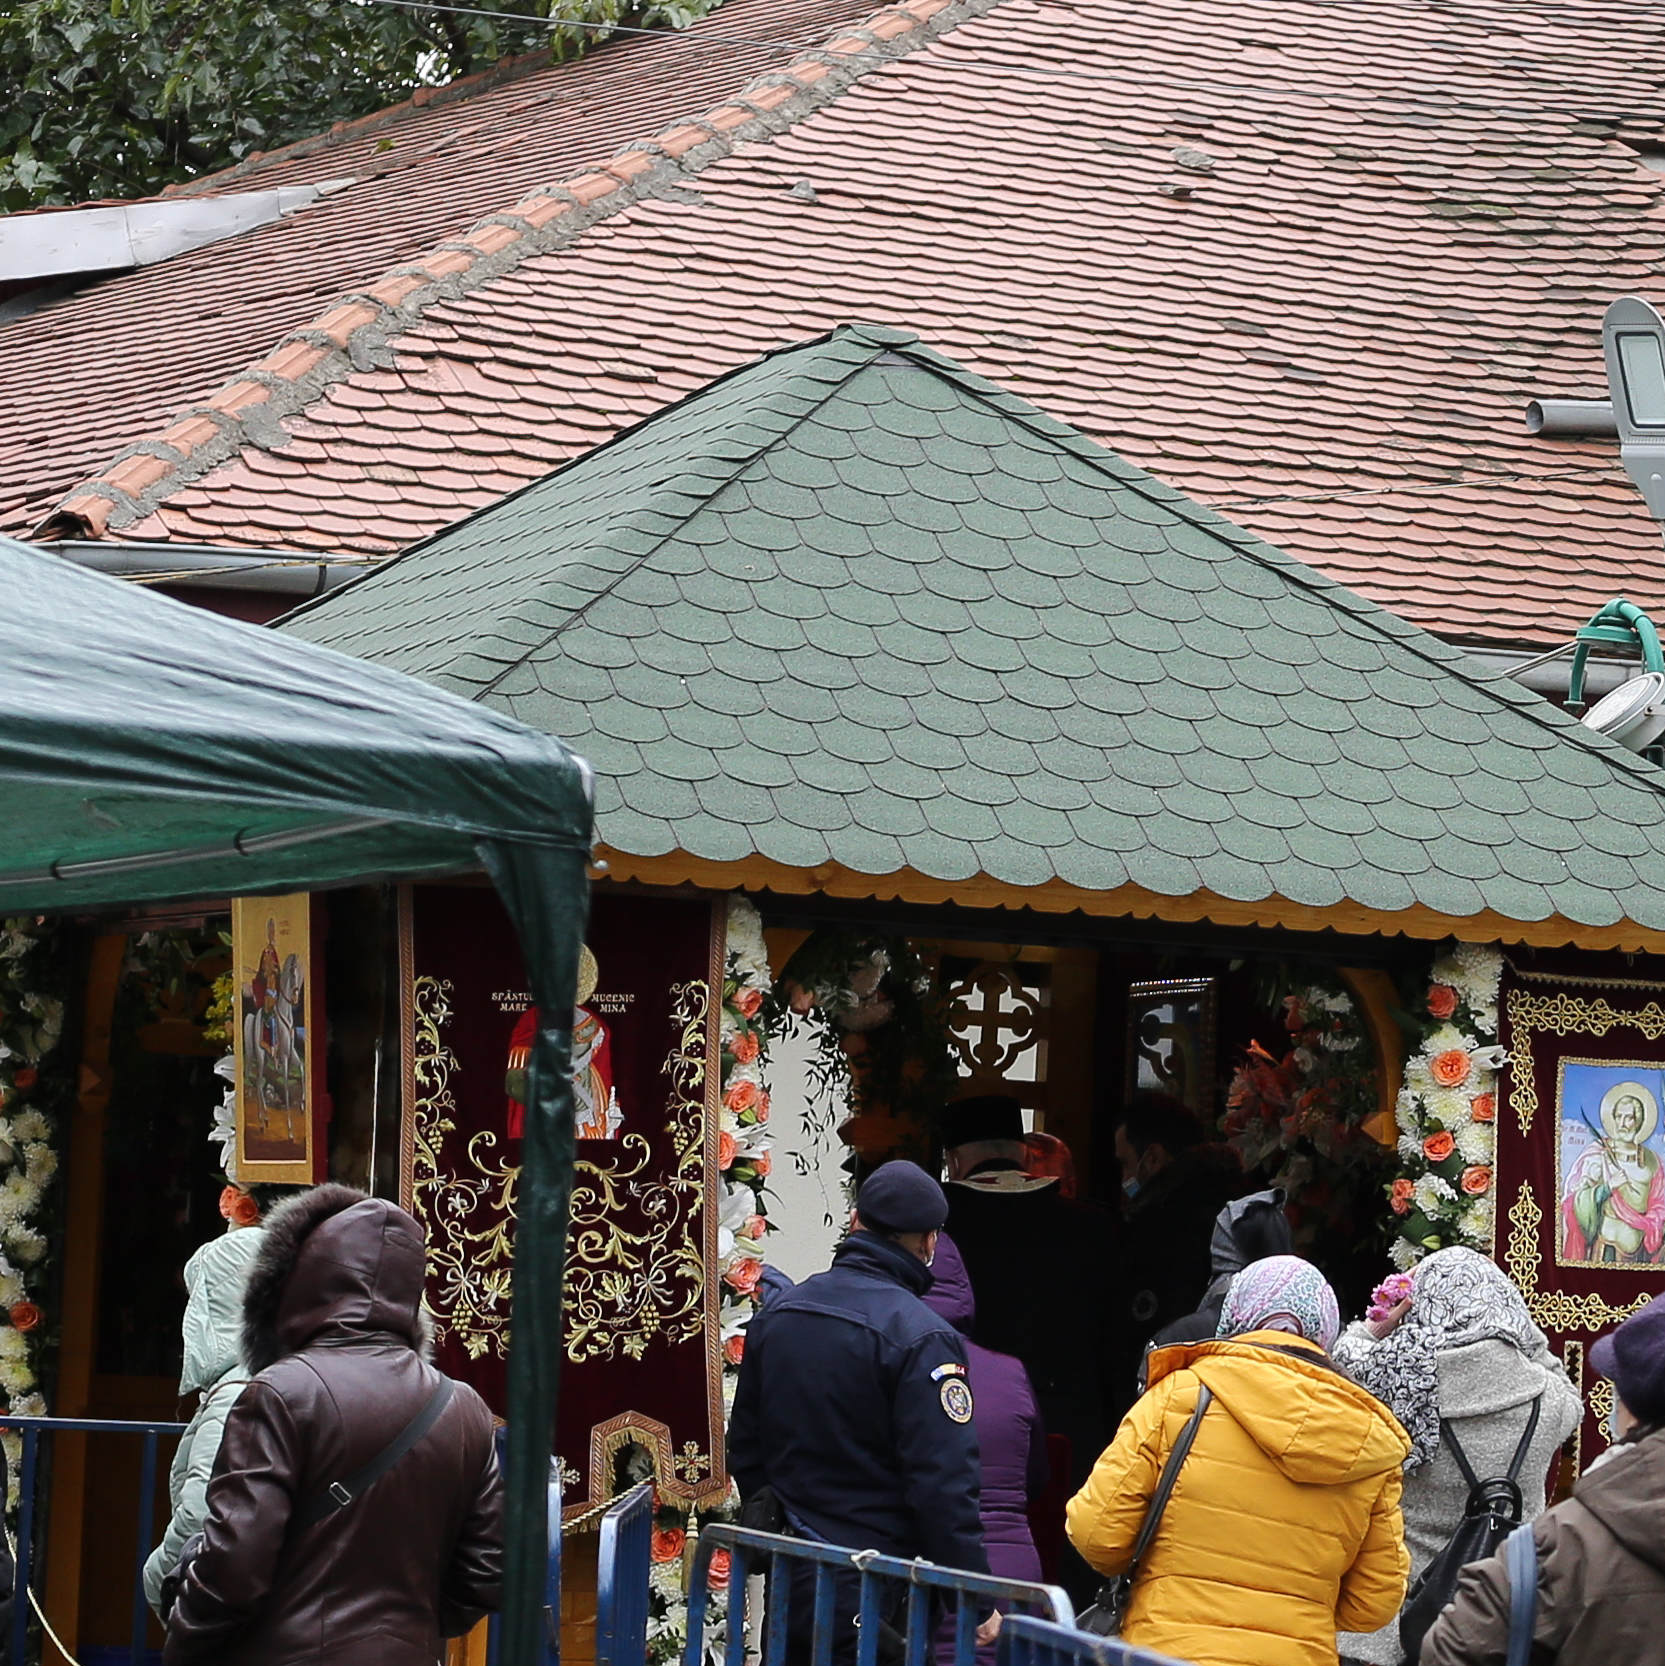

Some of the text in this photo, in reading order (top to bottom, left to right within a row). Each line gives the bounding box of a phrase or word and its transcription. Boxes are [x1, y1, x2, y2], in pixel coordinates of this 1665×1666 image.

[591, 993, 635, 1002] MUCENIC
[499, 1002, 527, 1011] MARE
[600, 1004, 626, 1013] MINA
